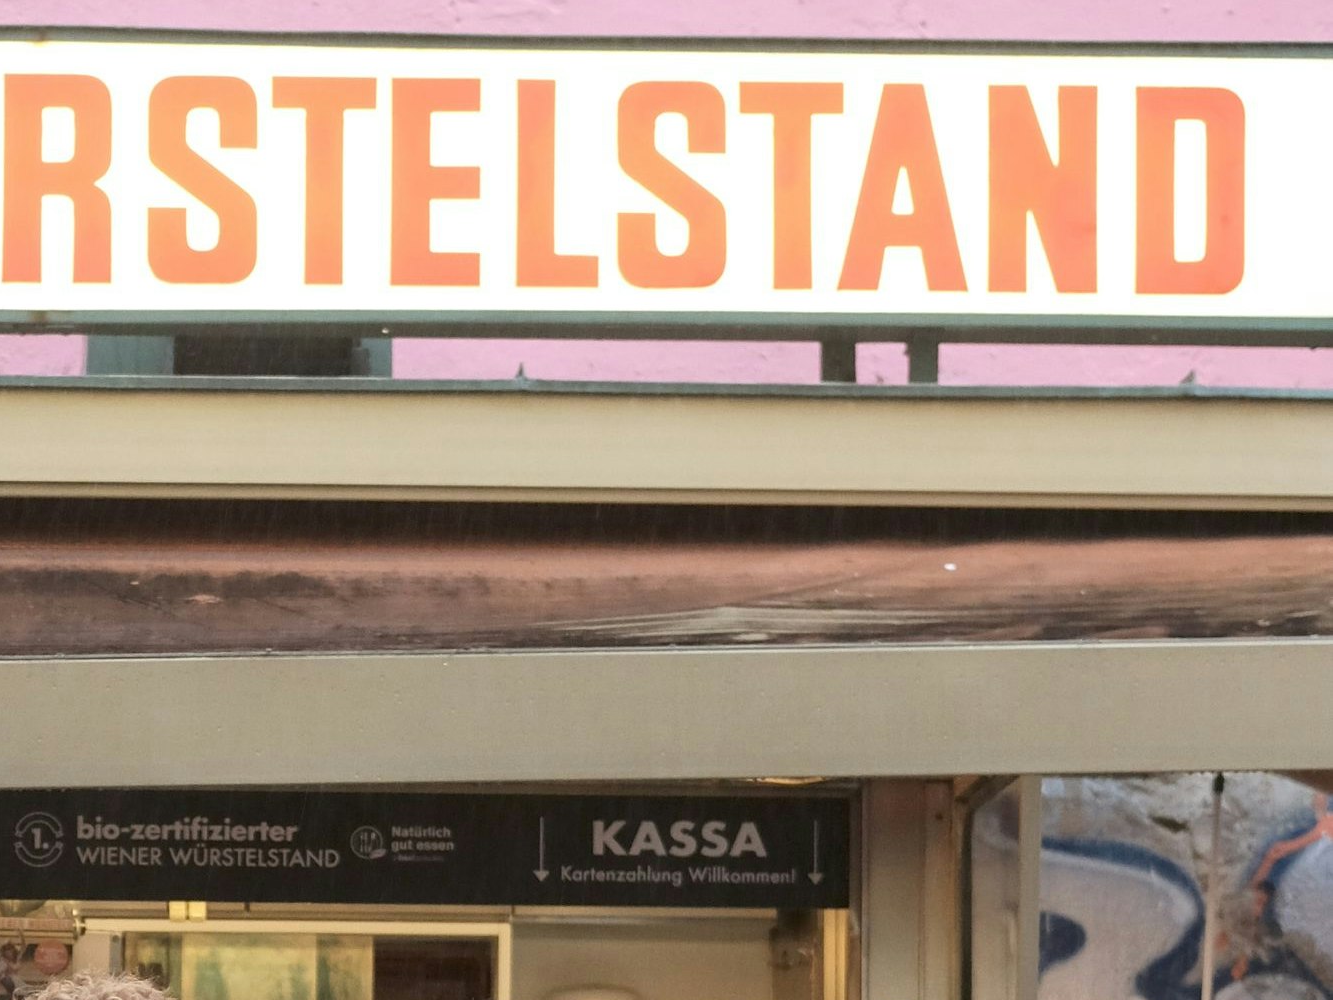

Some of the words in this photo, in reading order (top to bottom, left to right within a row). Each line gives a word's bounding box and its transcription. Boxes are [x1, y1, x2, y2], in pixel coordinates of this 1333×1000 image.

[76, 815, 299, 842] bio-zertifizierter
[391, 826, 451, 838] Natürlich
[592, 819, 768, 858] KASSA
[76, 846, 163, 866] WIENER
[169, 843, 341, 868] WÜRSTELSTAND
[391, 840, 414, 853] gut
[560, 866, 683, 887] Kartenzahlung
[688, 866, 797, 885] Willkommen!
